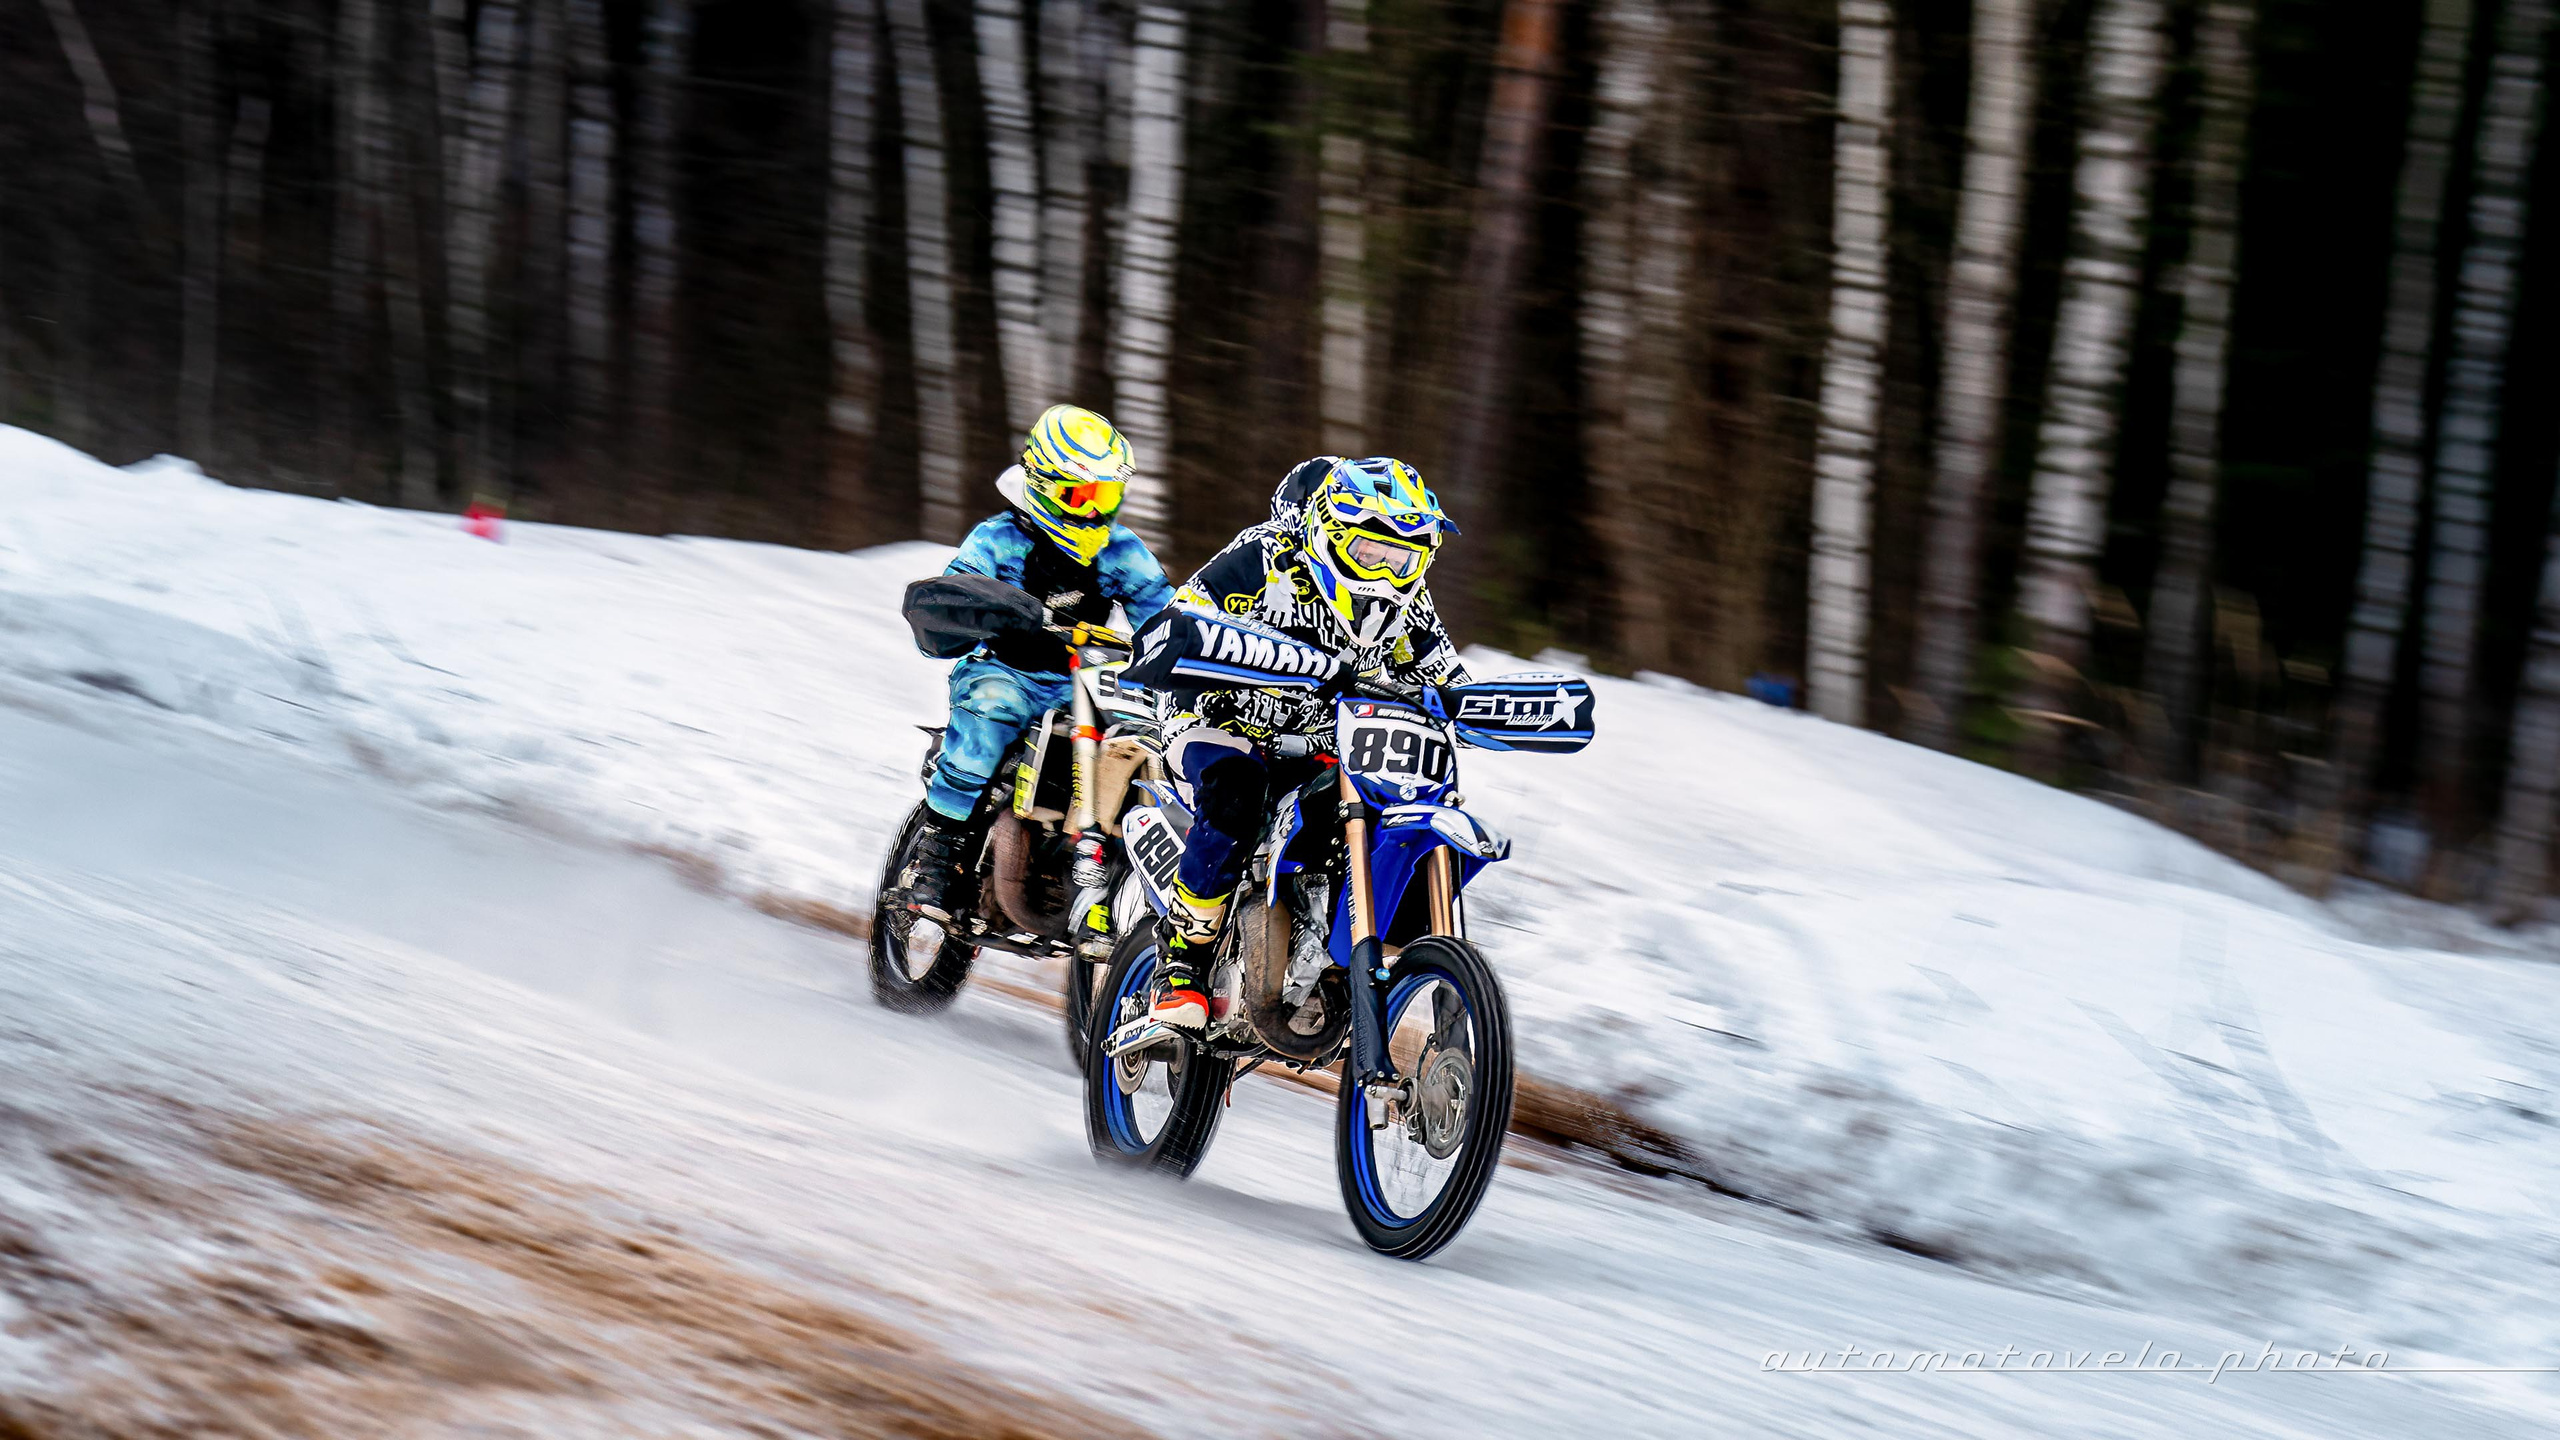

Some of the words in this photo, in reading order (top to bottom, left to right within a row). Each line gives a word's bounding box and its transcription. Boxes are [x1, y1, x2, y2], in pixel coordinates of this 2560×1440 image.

[1315, 490, 1345, 541] 100%
[1350, 727, 1452, 783] 890
[1133, 822, 1181, 891] 890
